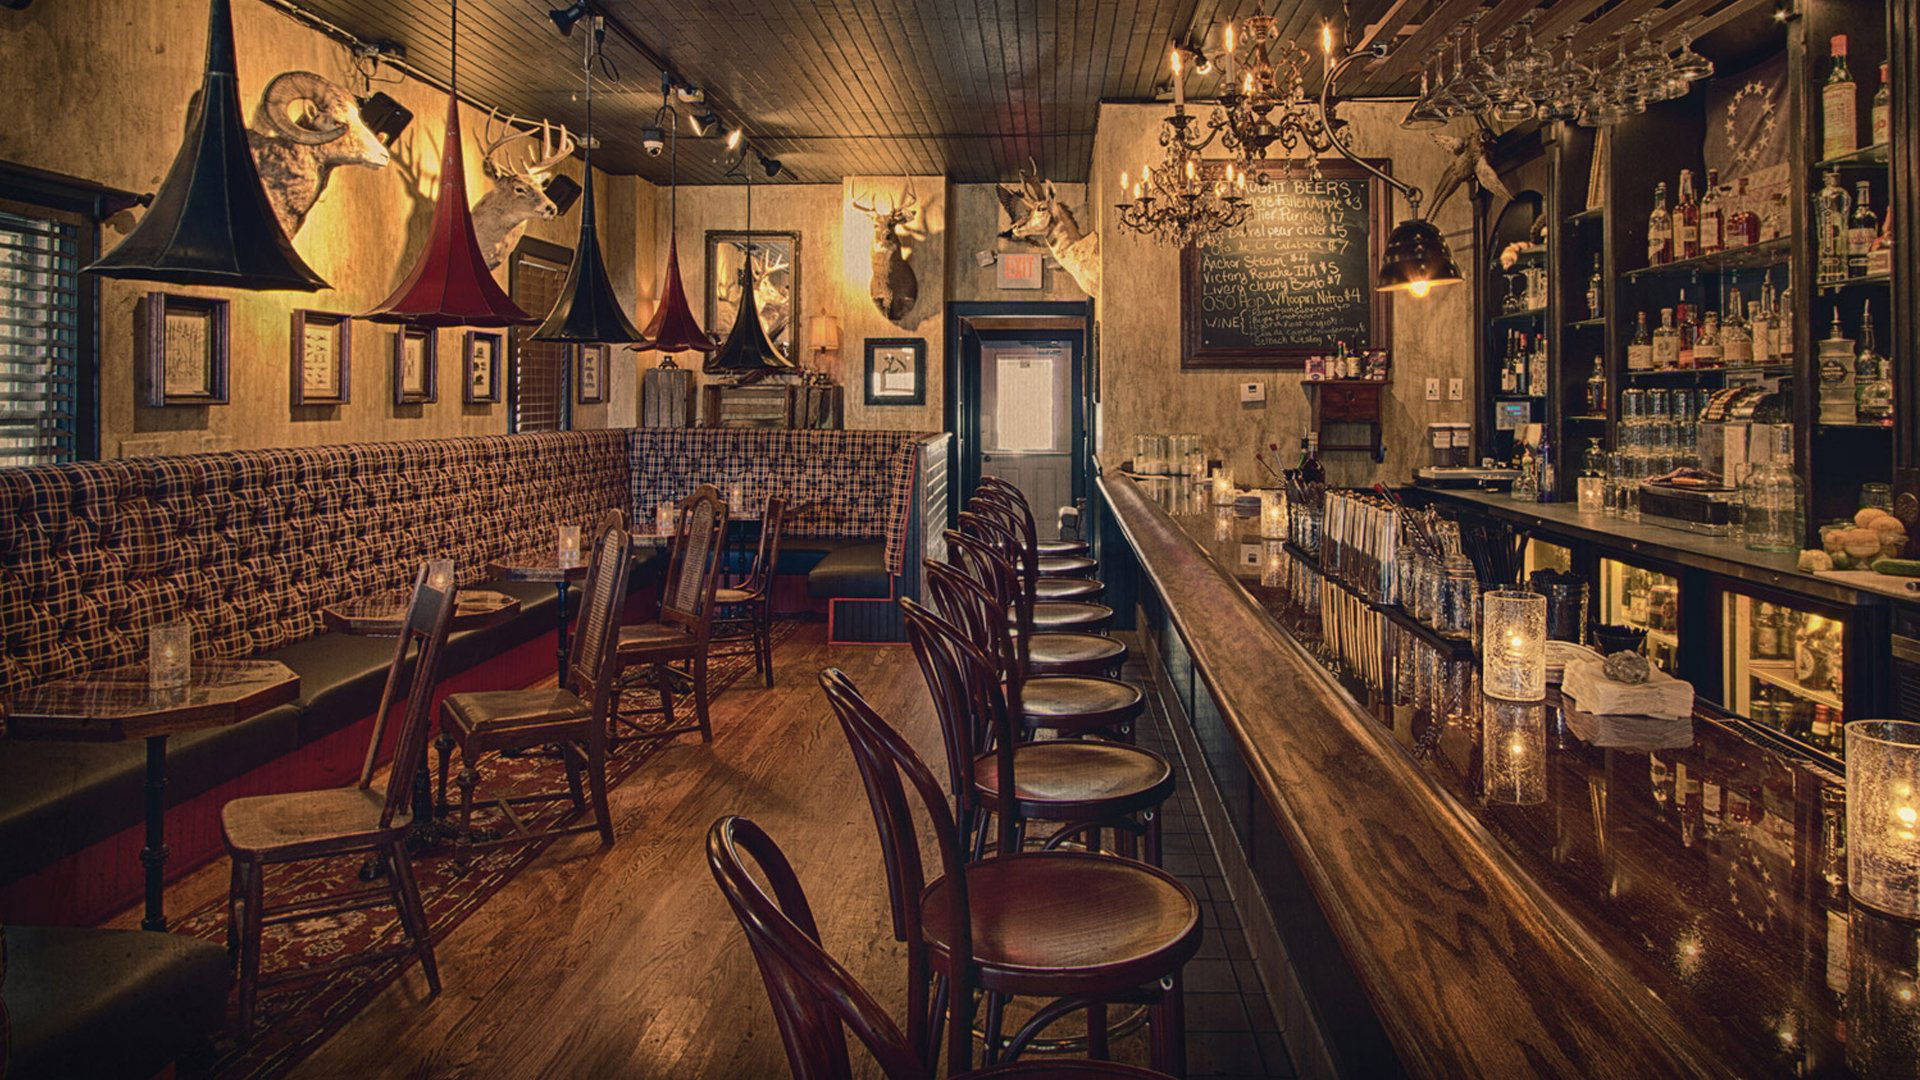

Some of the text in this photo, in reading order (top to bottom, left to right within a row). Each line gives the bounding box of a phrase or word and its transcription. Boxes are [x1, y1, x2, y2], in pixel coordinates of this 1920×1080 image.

[1293, 180, 1352, 198] BEERS
[1005, 255, 1034, 280] EXIT
[1203, 255, 1240, 272] Anchor
[1243, 255, 1287, 268] Steam
[1203, 270, 1248, 285] Victory
[1293, 264, 1317, 277] IPA
[1316, 290, 1344, 304] Nitro
[1205, 316, 1240, 328] WINE
